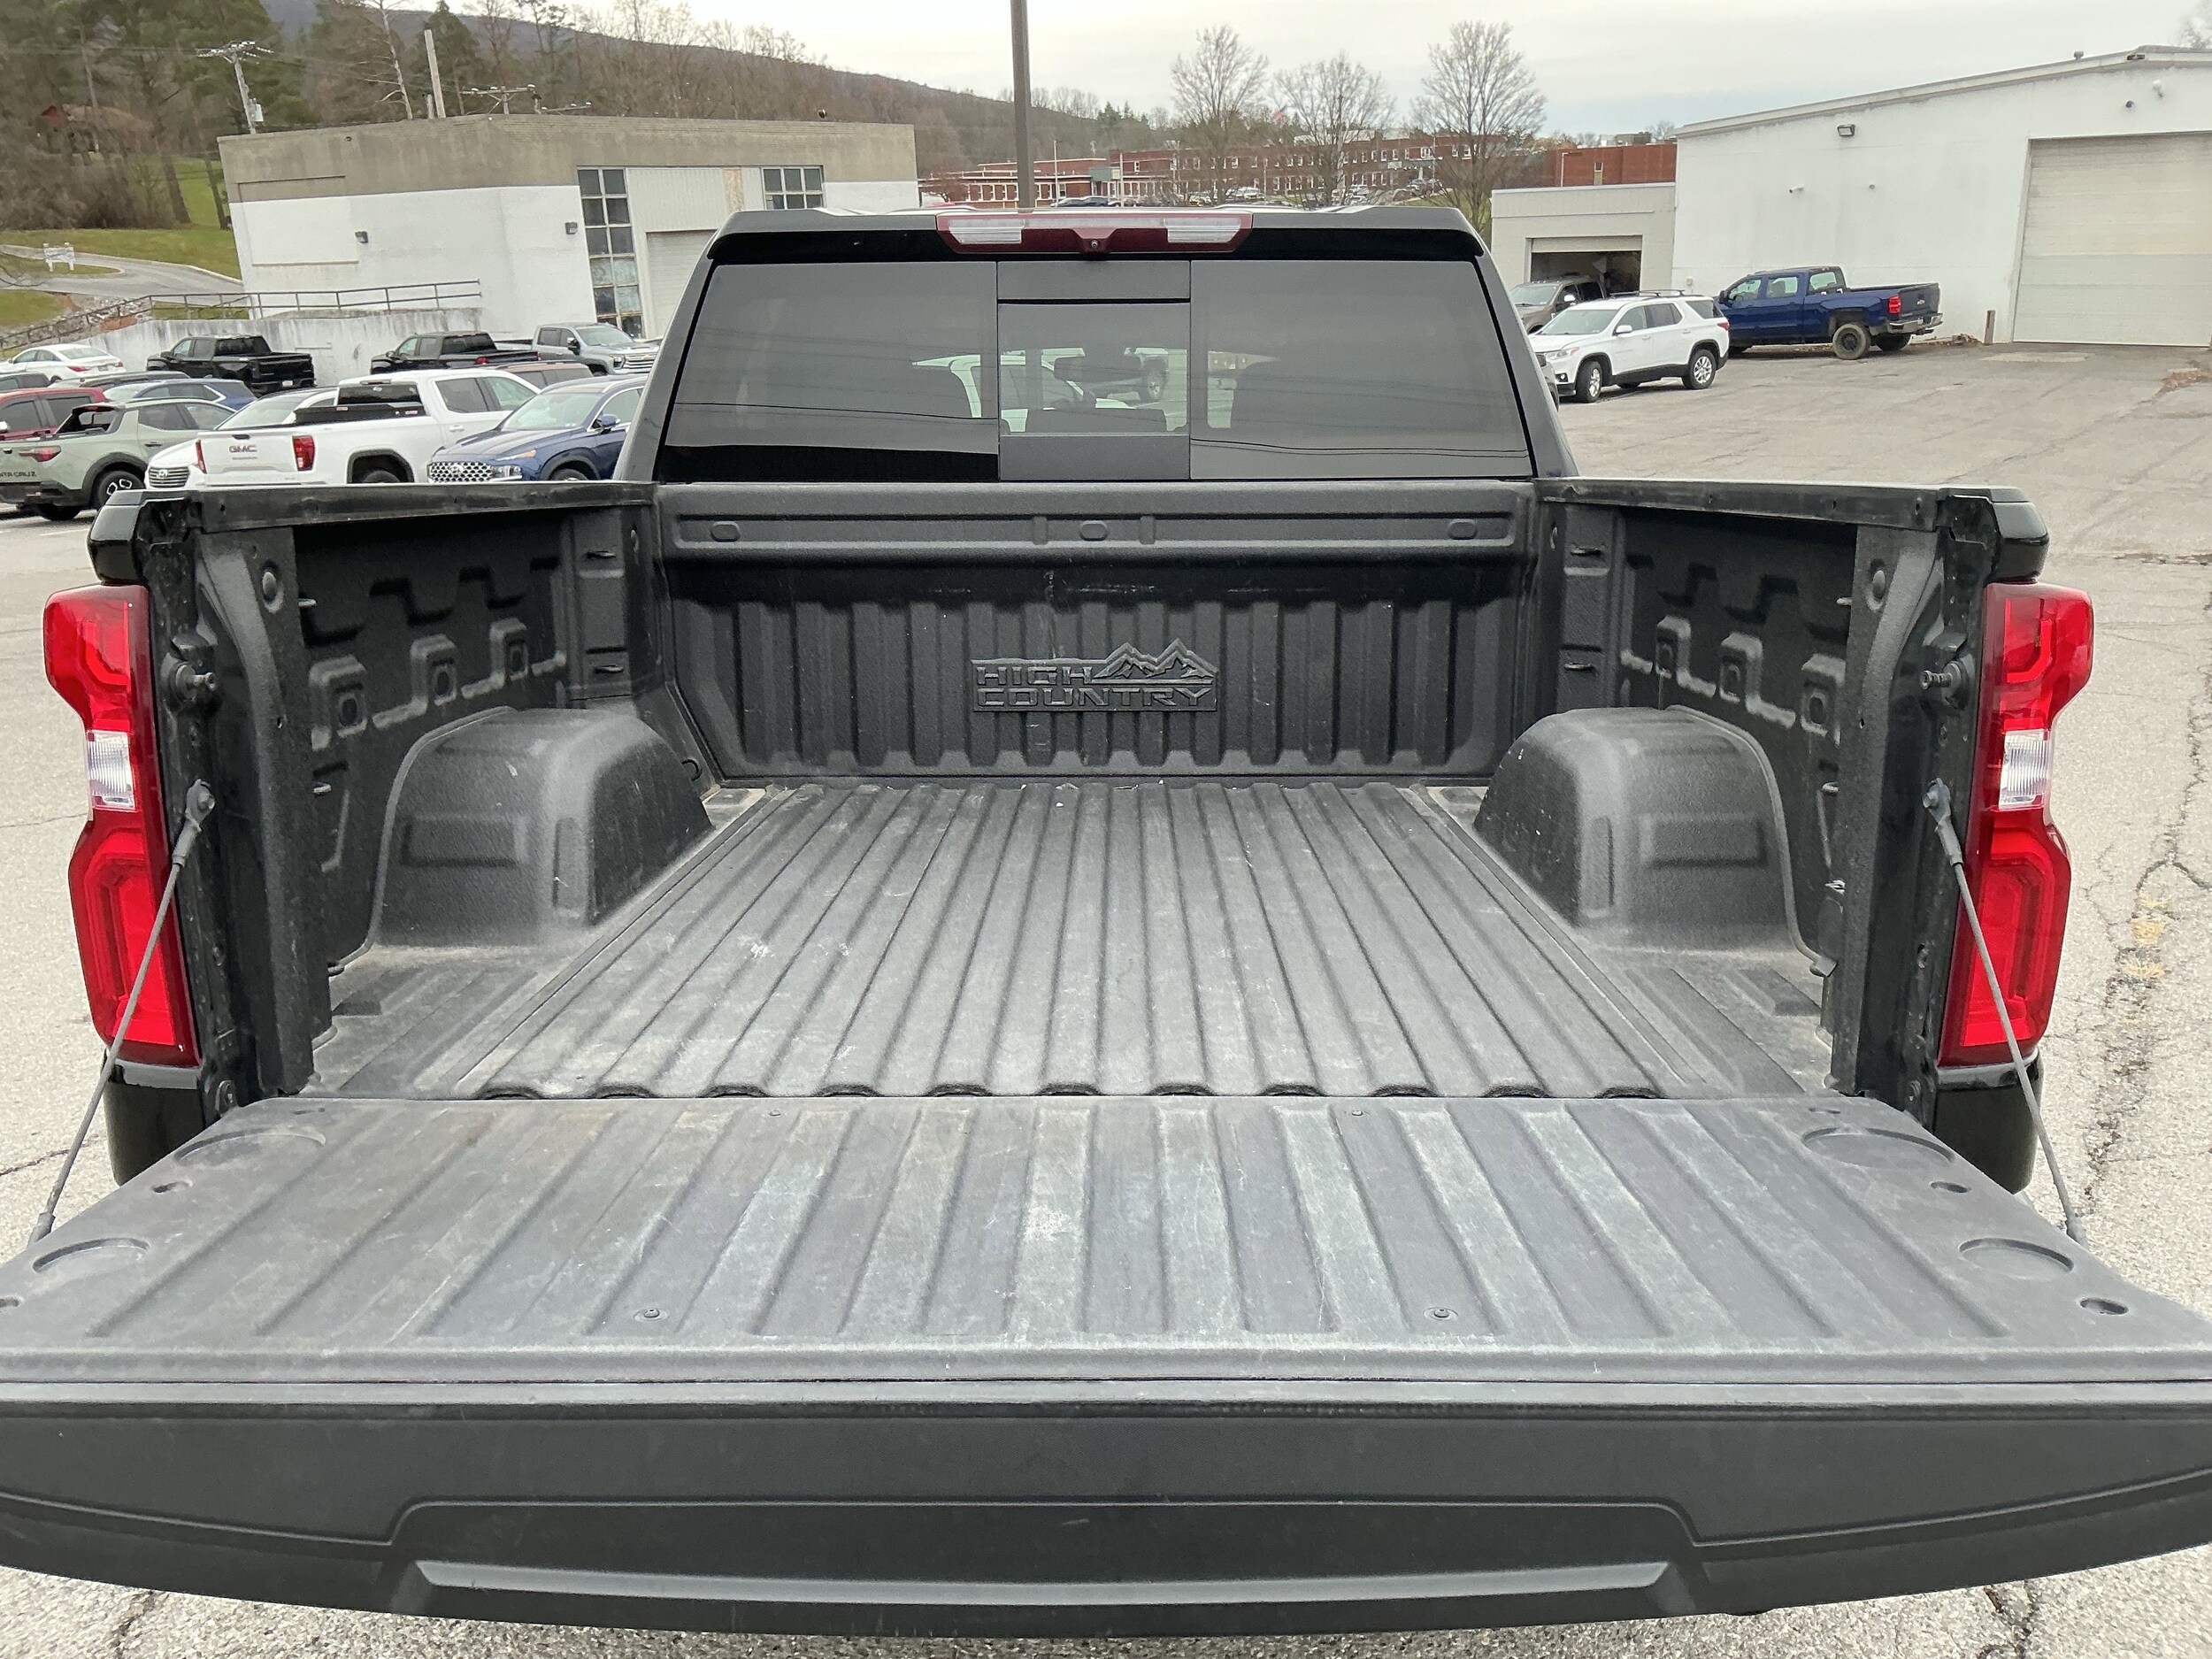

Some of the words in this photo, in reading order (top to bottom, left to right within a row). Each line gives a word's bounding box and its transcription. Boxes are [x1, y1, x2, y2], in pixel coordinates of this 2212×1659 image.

[229, 444, 257, 453] GMC
[976, 665, 1093, 686] HIGH
[976, 687, 1212, 707] COUNTRY
